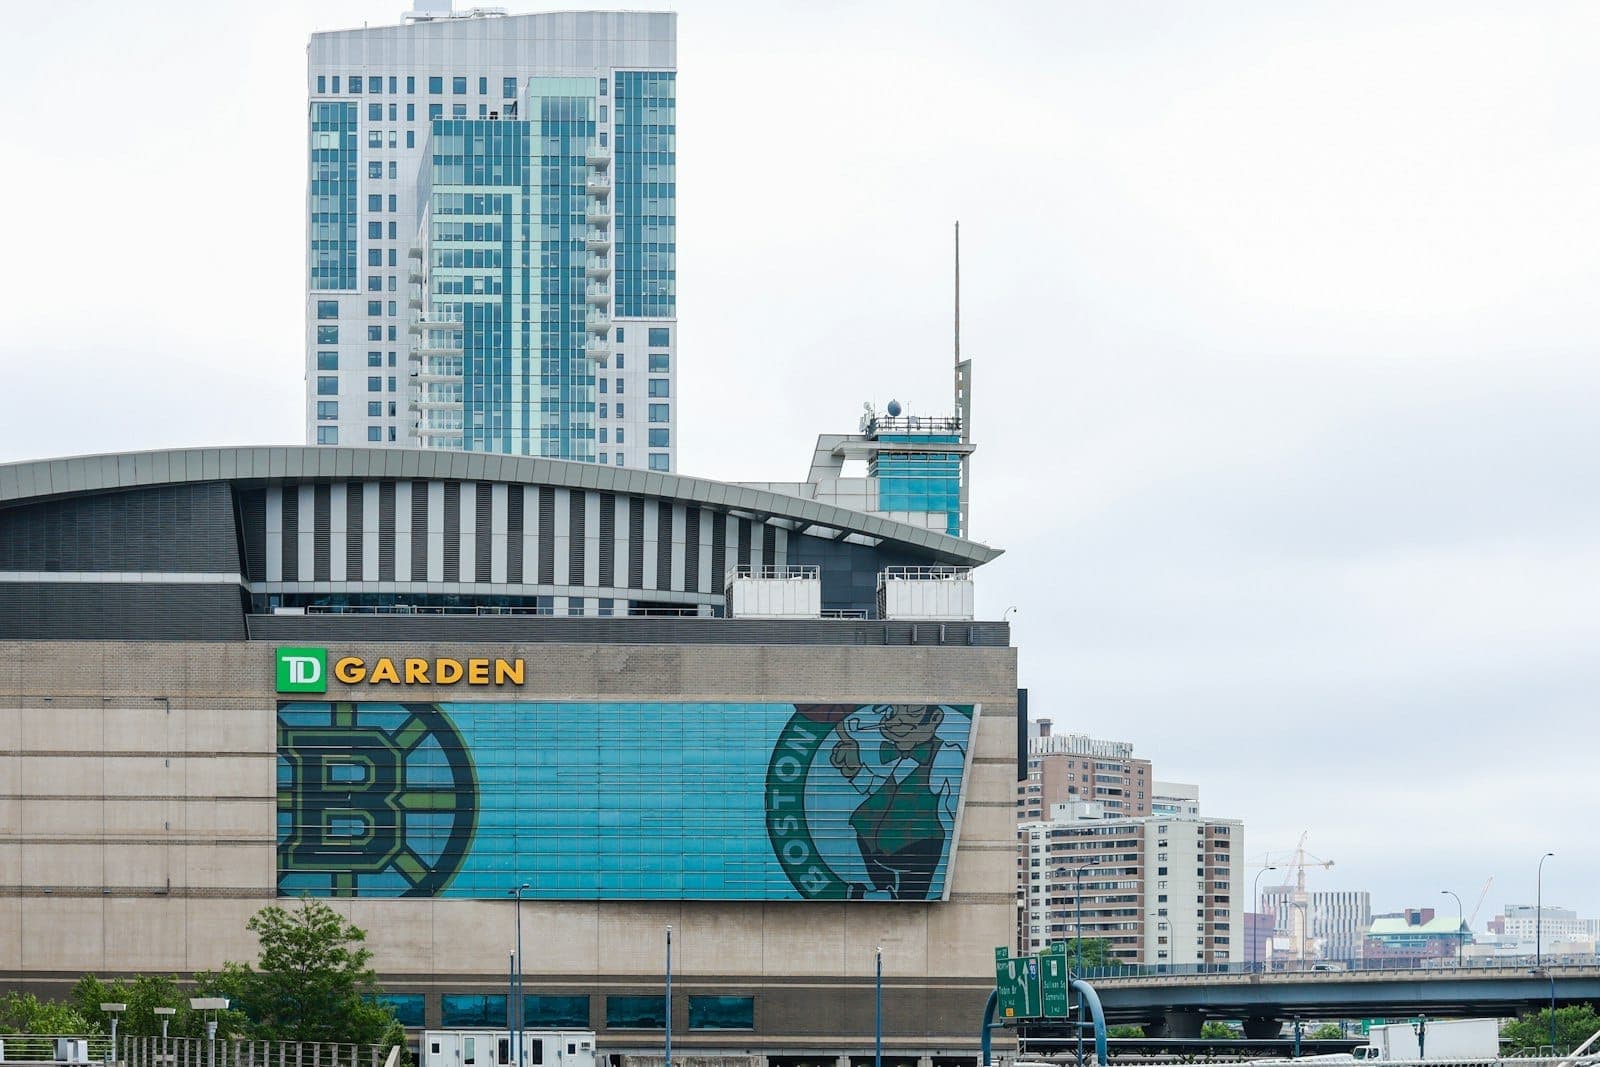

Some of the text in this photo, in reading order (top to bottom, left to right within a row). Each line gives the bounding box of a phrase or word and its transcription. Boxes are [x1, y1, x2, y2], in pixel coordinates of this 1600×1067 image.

[282, 656, 525, 685] TD GARDEN
[288, 731, 401, 870] B
[773, 725, 831, 896] BOSTON
